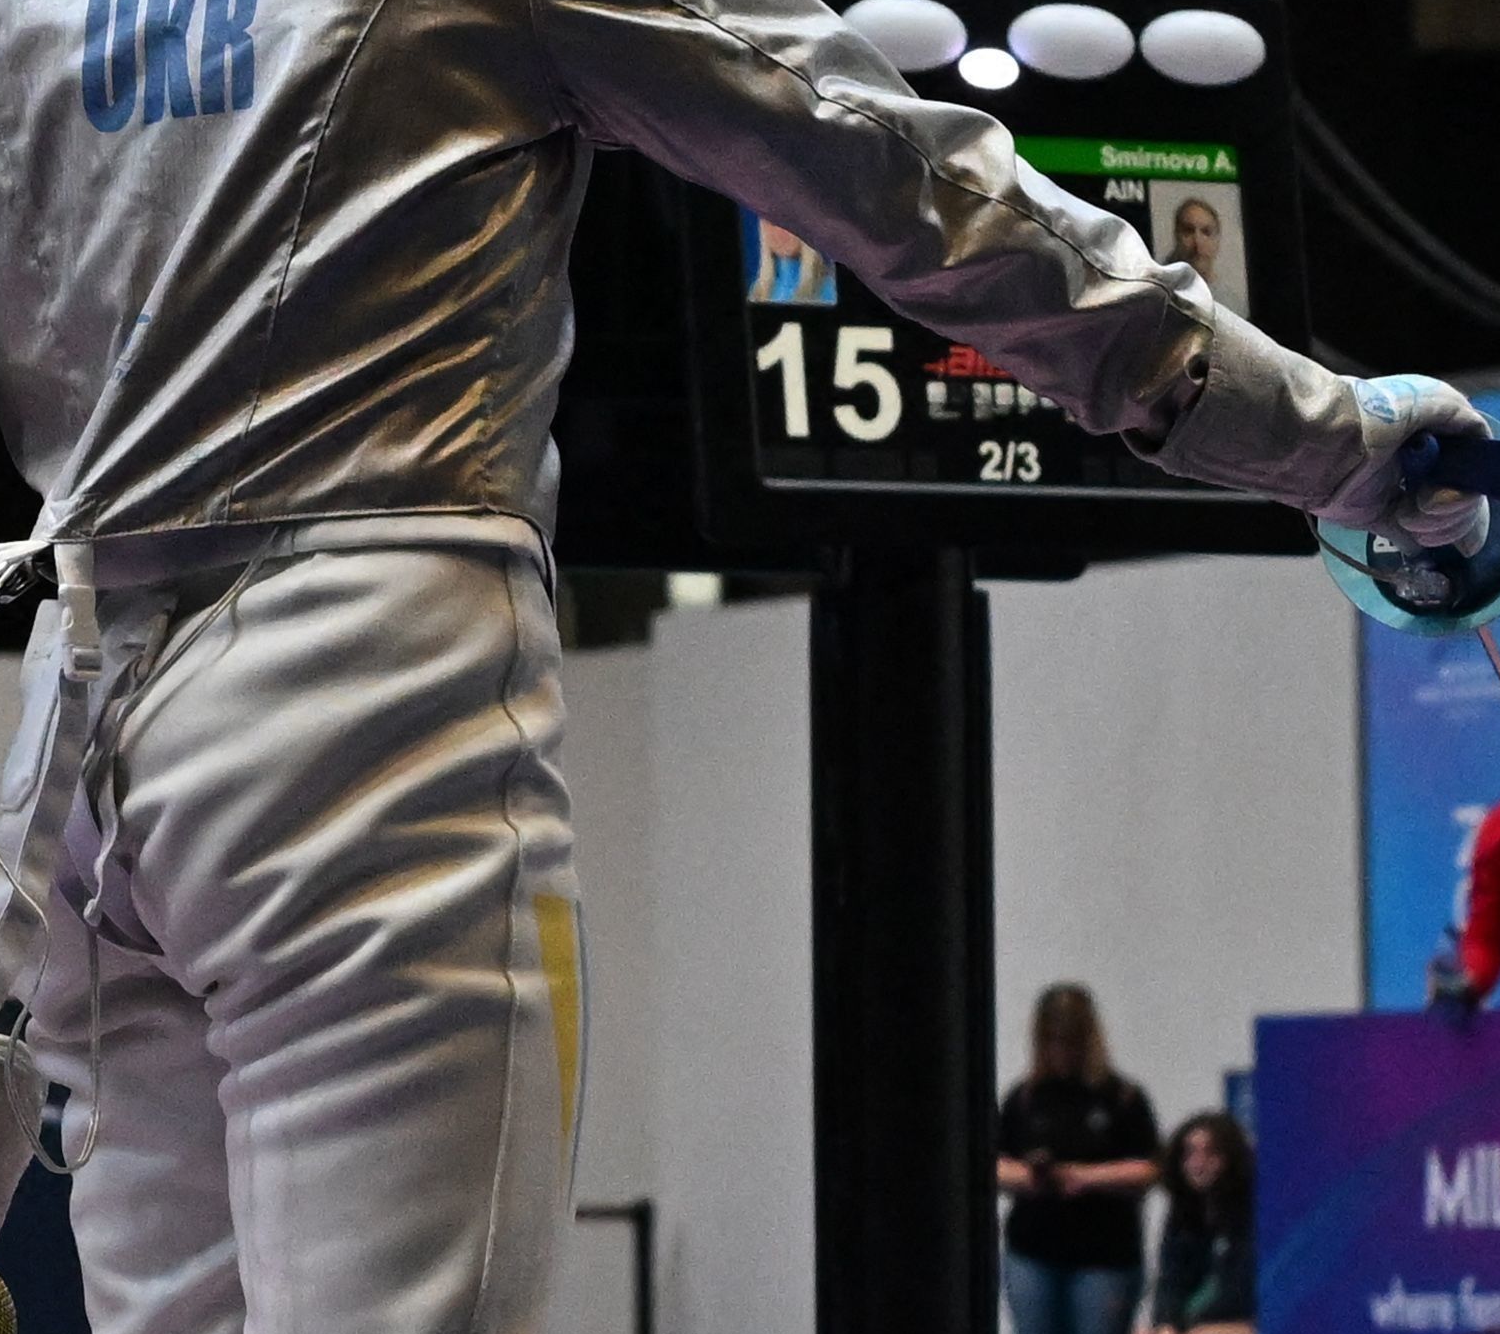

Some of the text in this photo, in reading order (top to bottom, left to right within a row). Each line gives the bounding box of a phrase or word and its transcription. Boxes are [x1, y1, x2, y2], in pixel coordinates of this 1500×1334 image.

[1101, 144, 1209, 174] Smirnova
[1104, 177, 1147, 203] AIN
[755, 322, 902, 442] 15
[978, 440, 1042, 483] 2/3
